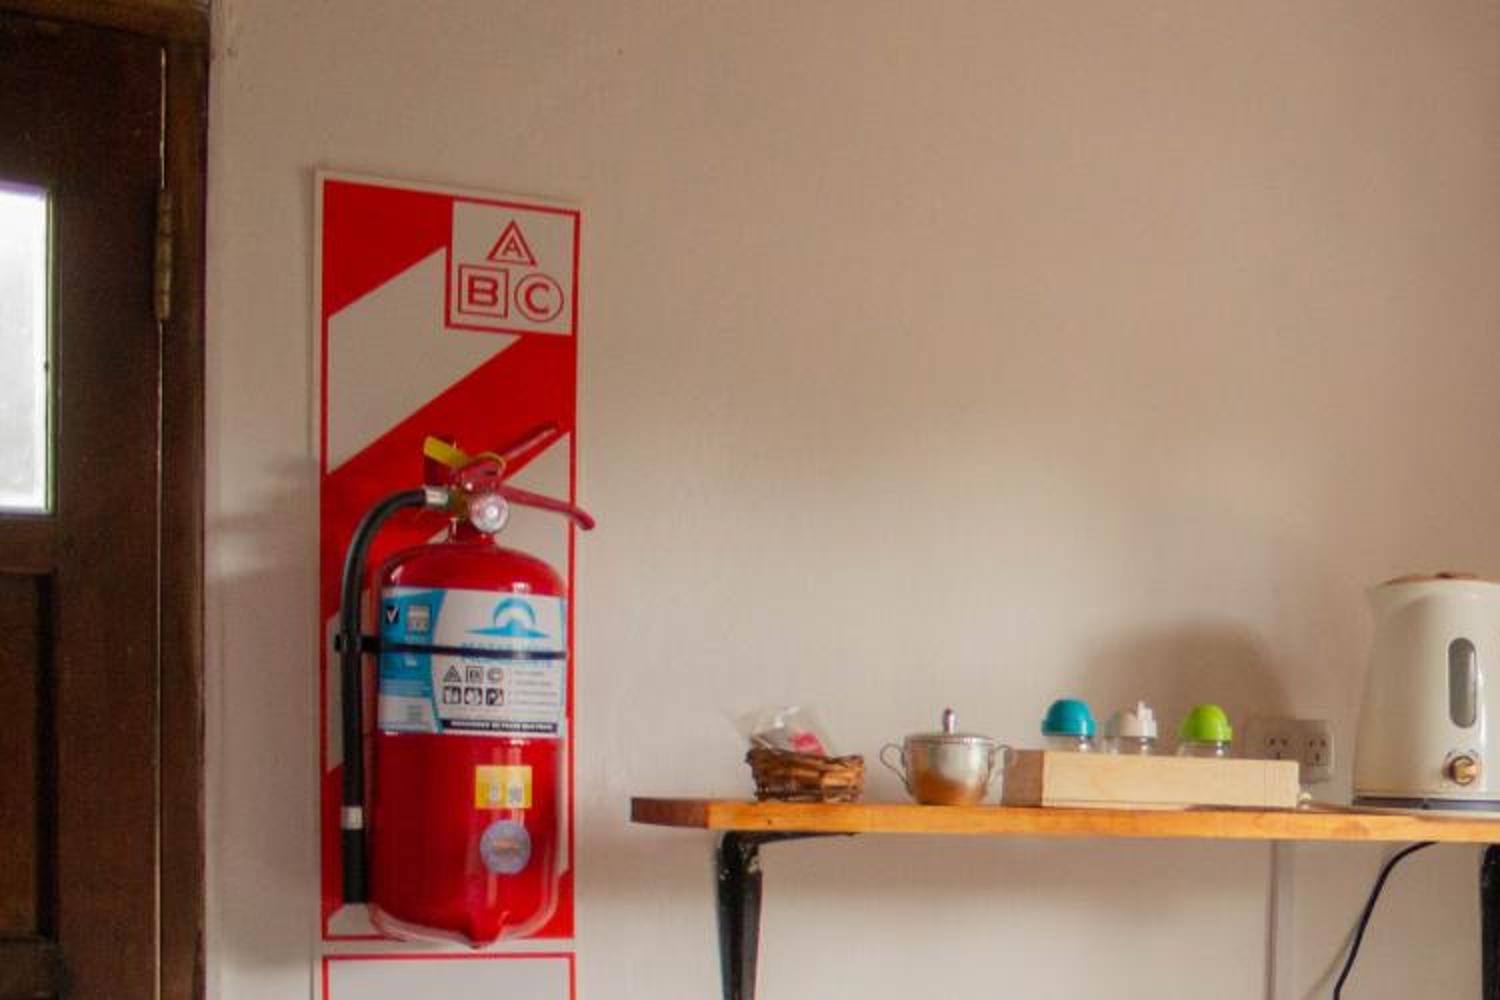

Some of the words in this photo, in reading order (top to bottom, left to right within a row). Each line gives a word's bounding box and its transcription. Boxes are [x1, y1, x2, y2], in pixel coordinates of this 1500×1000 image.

[501, 236, 523, 257] A
[467, 275, 499, 307] B
[524, 281, 550, 315] C
